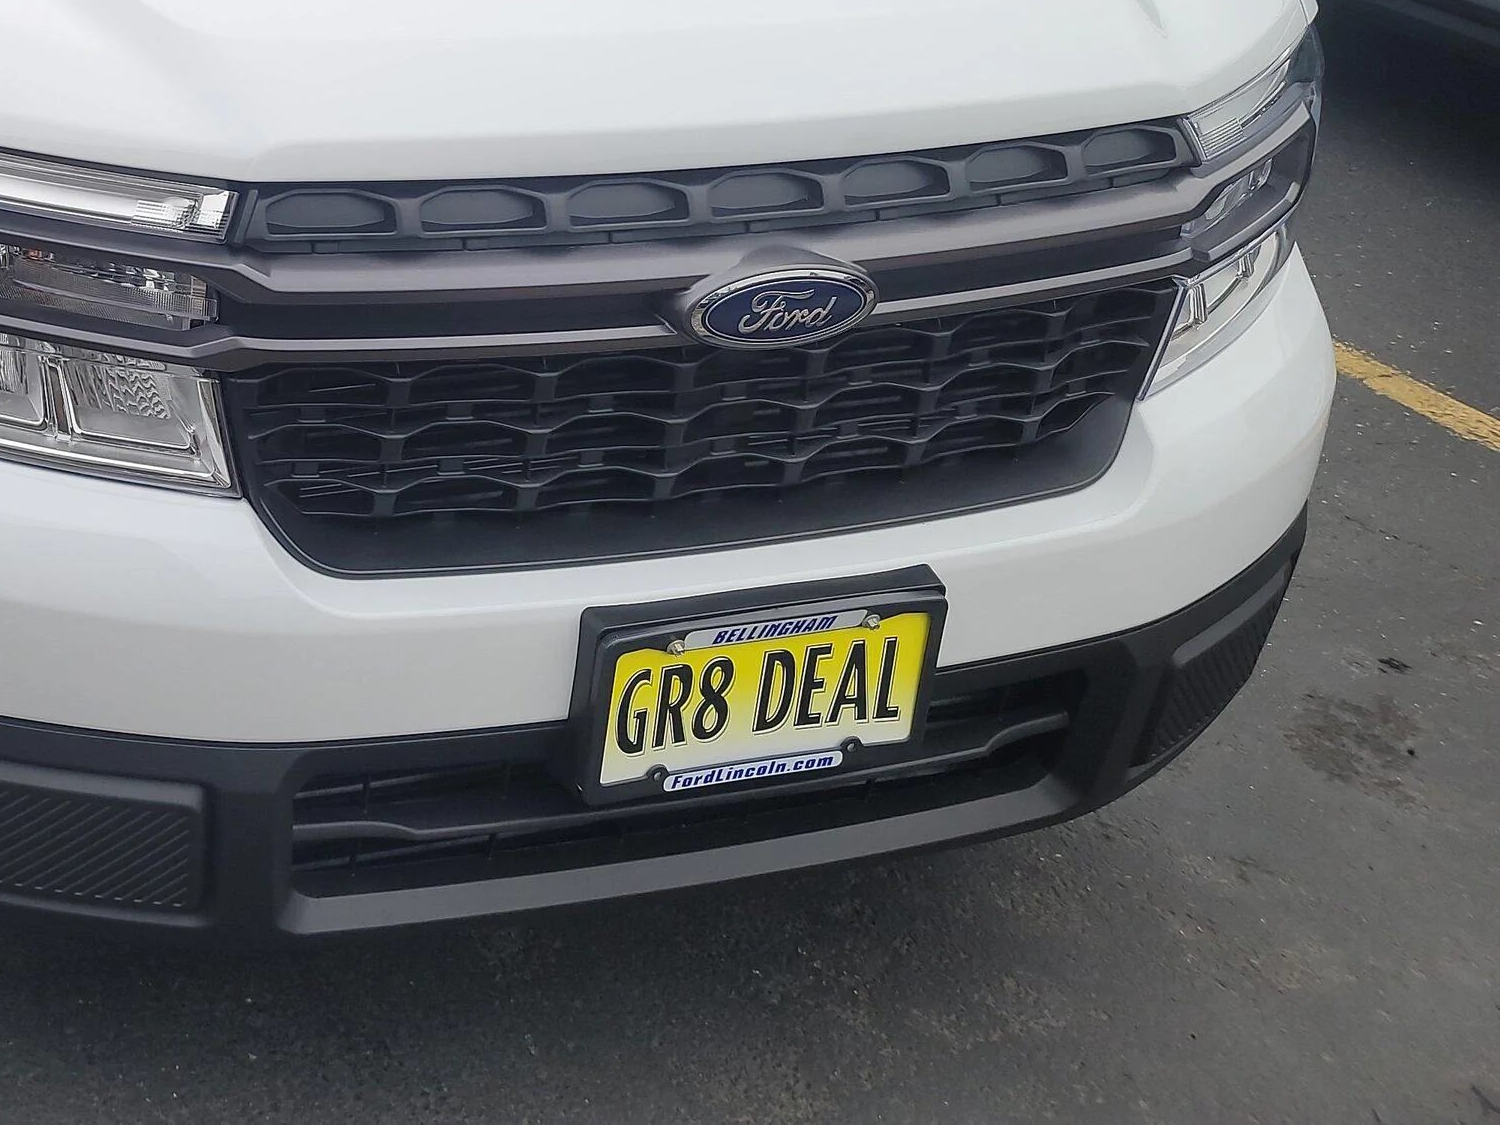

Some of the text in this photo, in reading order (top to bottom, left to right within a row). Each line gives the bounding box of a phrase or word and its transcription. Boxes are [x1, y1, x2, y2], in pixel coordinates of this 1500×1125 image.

[738, 289, 839, 335] Ford
[712, 615, 839, 645] BELLINGHAM
[614, 636, 900, 756] GR8 DEAL
[670, 755, 834, 790] FordLincoln.com
